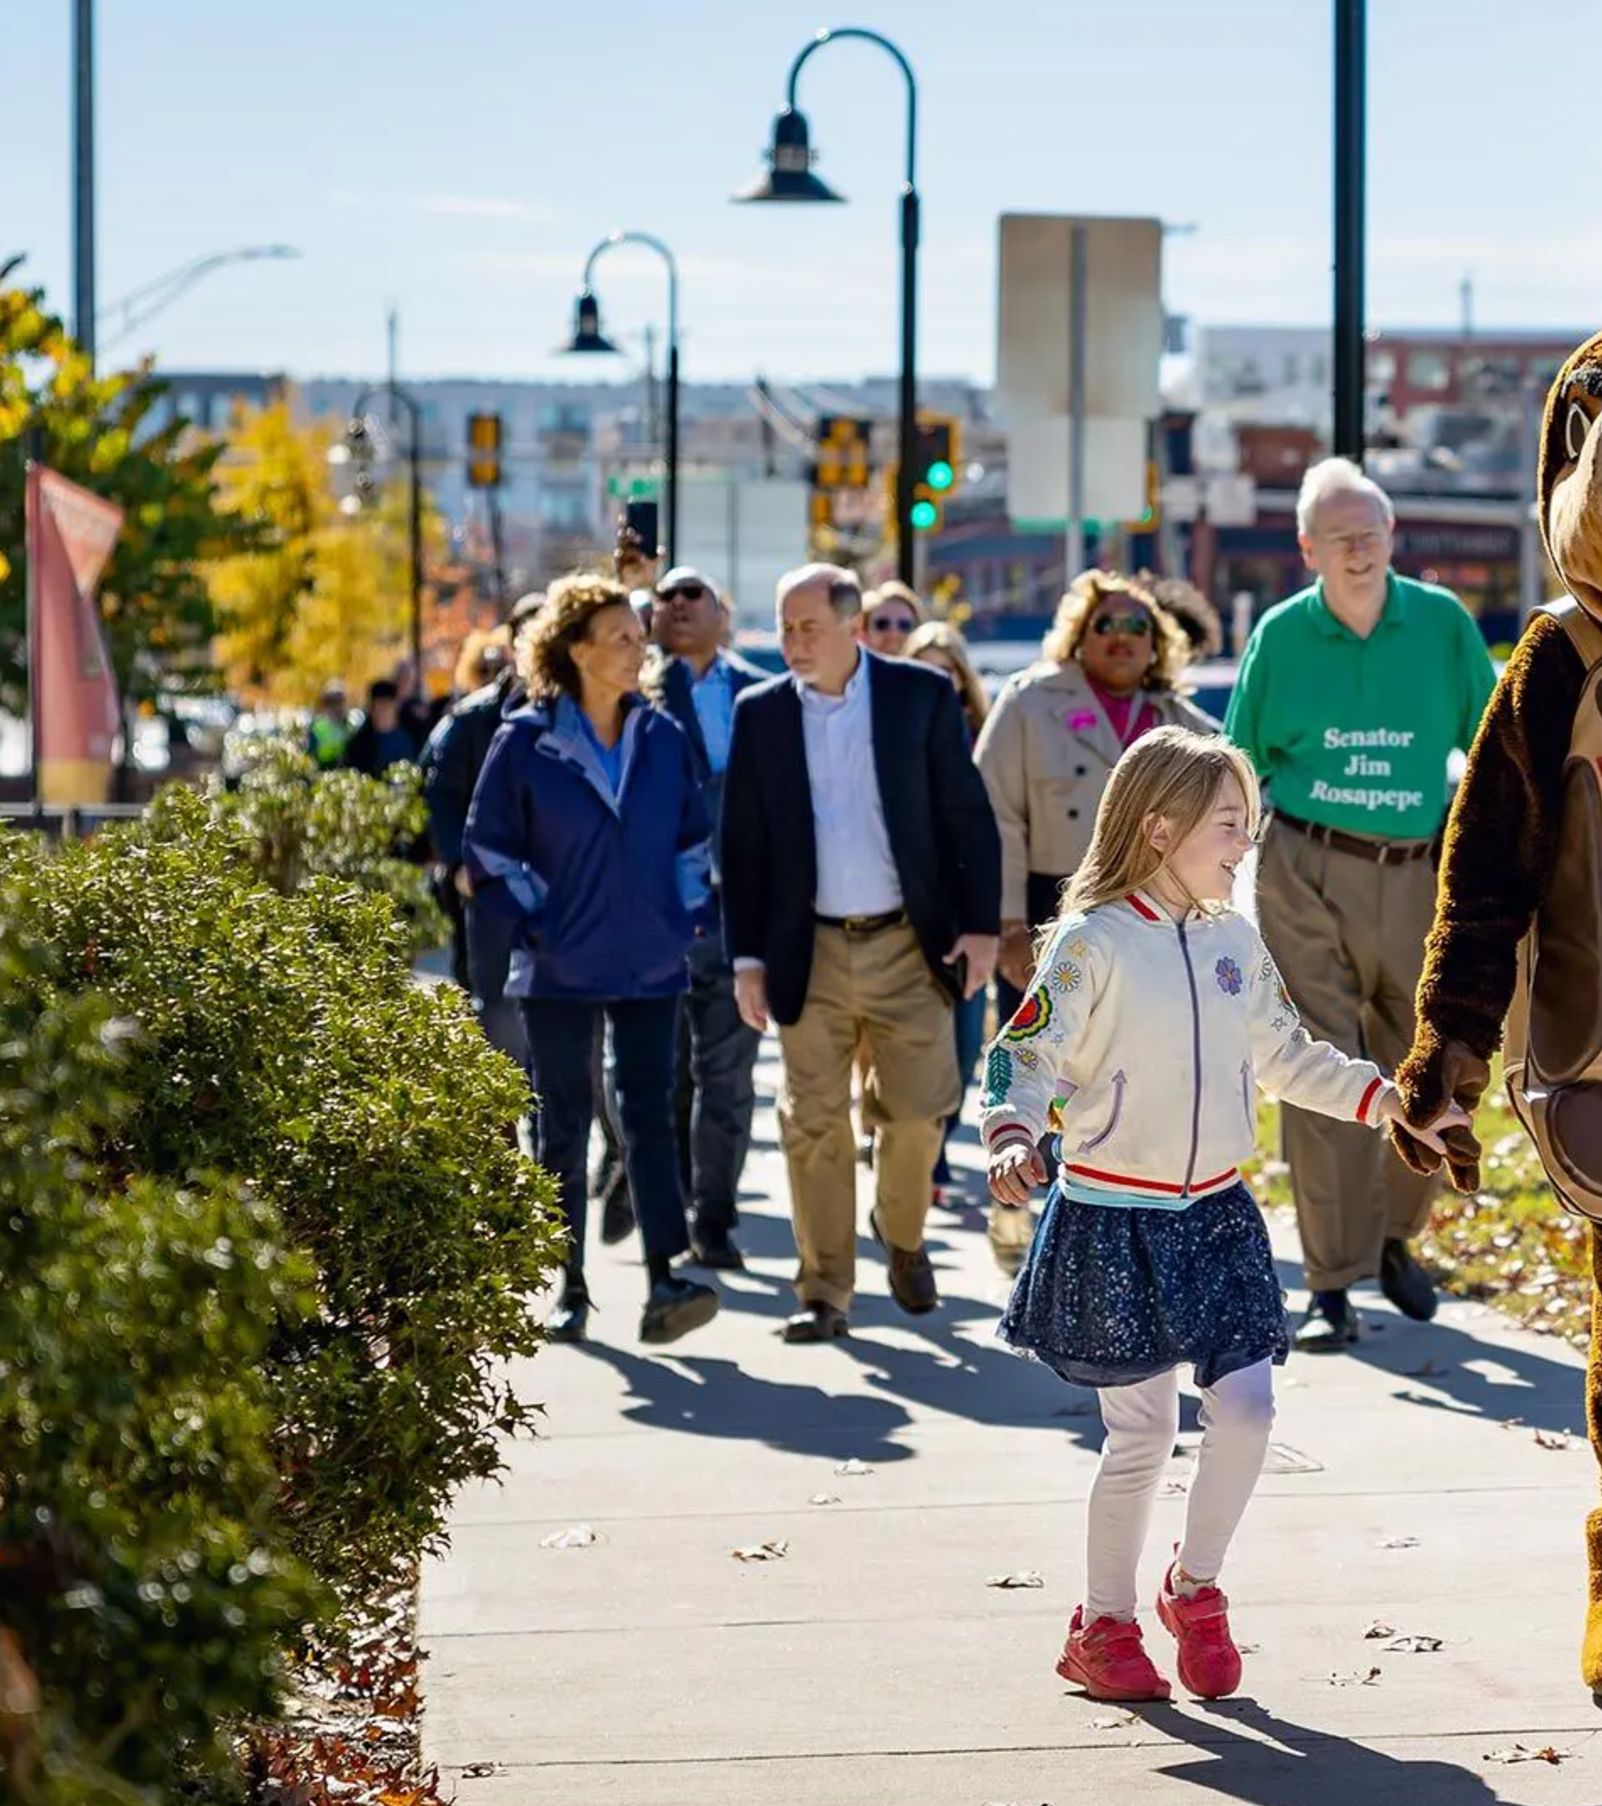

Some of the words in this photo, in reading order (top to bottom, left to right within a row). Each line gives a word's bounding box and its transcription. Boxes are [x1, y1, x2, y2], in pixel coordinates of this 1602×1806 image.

[1324, 727, 1414, 748] Senator
[1344, 754, 1390, 776] Jim
[1310, 780, 1422, 811] Rosapepe
